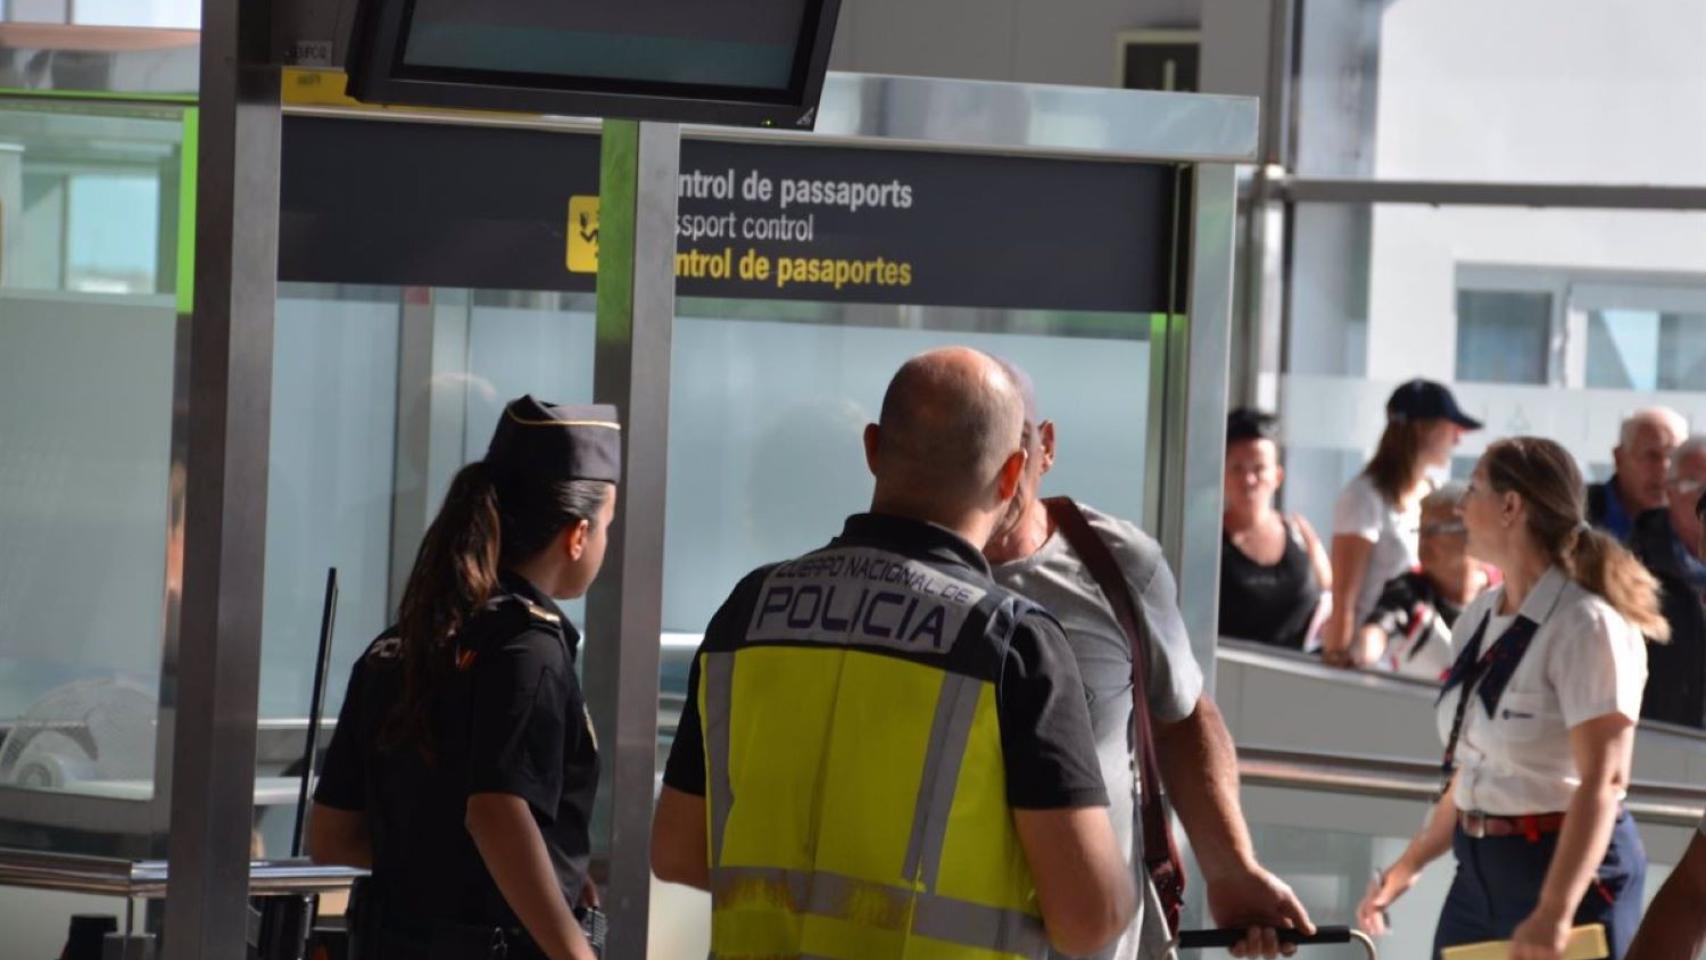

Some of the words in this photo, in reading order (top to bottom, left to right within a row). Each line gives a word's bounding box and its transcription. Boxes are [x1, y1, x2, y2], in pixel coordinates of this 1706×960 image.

[678, 169, 734, 199] ntrol
[742, 171, 772, 201] de
[780, 176, 913, 212] passaports
[676, 212, 736, 241] sport
[743, 213, 814, 241] control
[675, 247, 731, 278] ntrol
[739, 248, 769, 280] de
[777, 255, 912, 289] pasaportes
[843, 556, 935, 593] NACIONAL
[940, 583, 972, 603] DE
[756, 584, 946, 649] POLICIA
